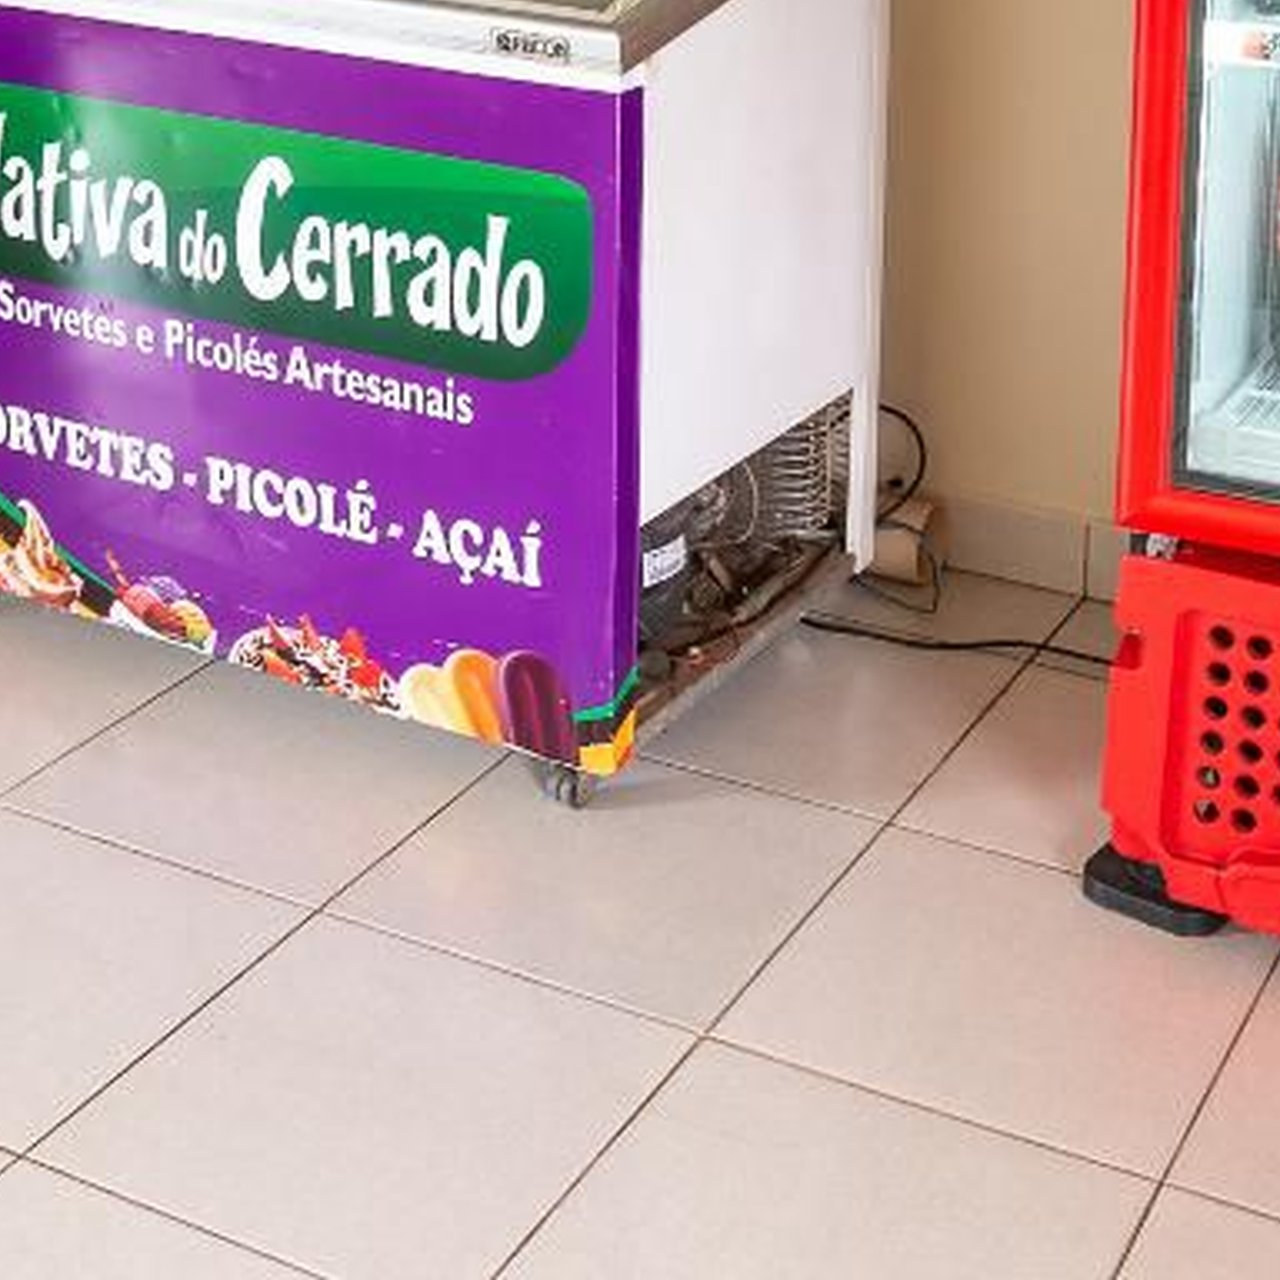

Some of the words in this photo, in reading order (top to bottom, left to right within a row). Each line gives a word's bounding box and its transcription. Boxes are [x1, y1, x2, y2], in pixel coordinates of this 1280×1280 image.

[179, 209, 227, 285] do
[235, 156, 546, 348] Cerrado
[135, 328, 155, 355] e
[164, 318, 279, 383] Picolés
[283, 345, 474, 426] Artesanais
[205, 456, 378, 545] PICOLÉ
[412, 510, 543, 589] AÇAÍ
